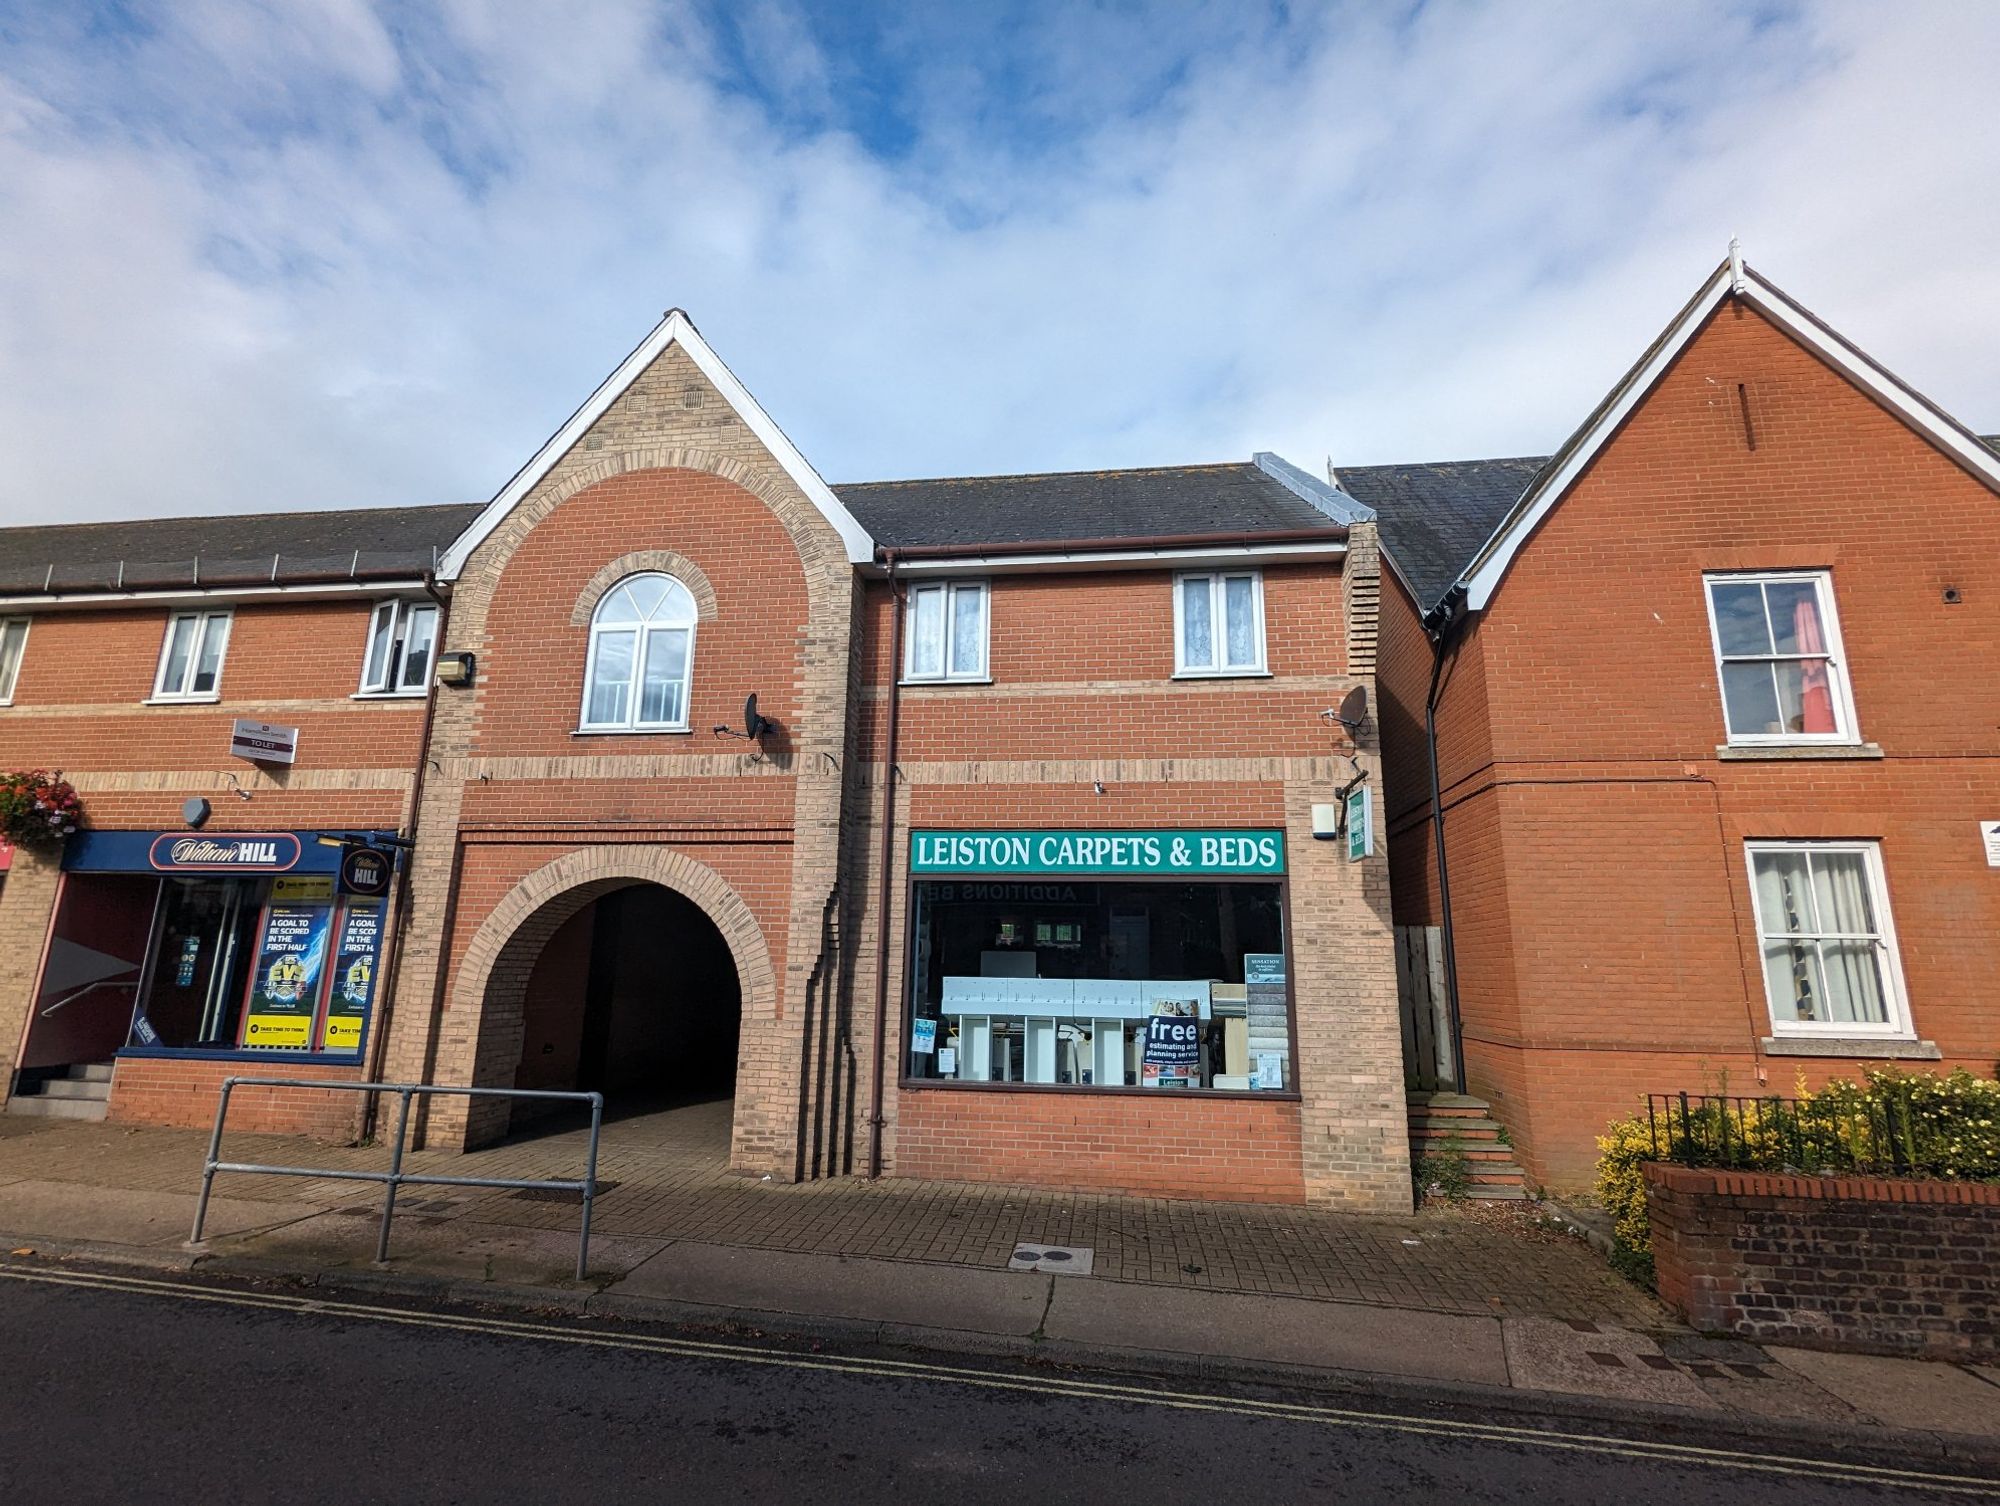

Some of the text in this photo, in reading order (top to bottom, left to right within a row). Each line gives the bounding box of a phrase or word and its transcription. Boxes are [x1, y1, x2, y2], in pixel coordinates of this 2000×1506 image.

[263, 741, 275, 749] LET
[171, 838, 277, 862] William HILL
[918, 837, 1276, 867] LEISTON CARPETS & BEDS
[354, 868, 378, 885] HILL
[344, 944, 366, 952] FIRST
[1151, 1018, 1197, 1041] free
[1149, 1042, 1185, 1051] estimating
[1146, 1050, 1177, 1059] planning
